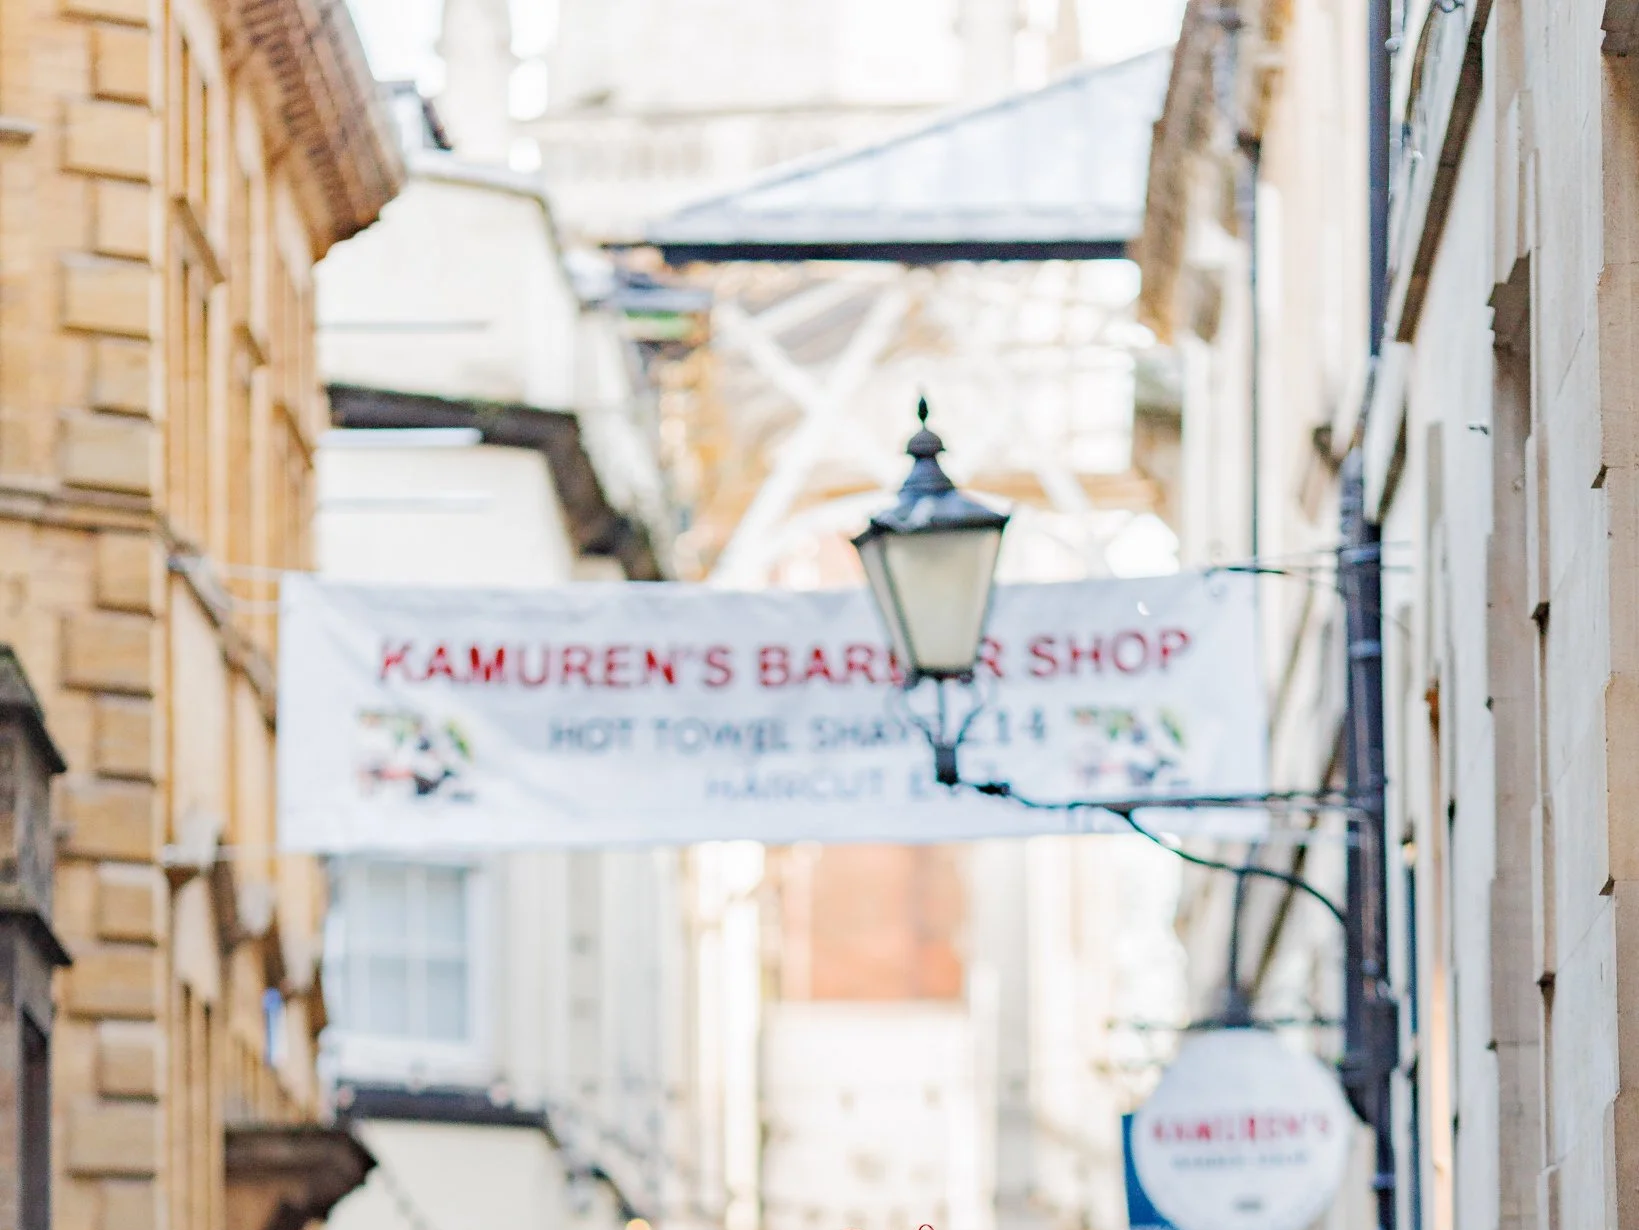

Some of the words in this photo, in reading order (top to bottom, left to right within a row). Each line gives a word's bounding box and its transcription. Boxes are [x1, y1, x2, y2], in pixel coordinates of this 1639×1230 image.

[380, 639, 734, 688] KAMUREN'S
[758, 634, 1004, 688] BARR
[1029, 627, 1191, 678] SHOP
[549, 717, 633, 754] HOT
[653, 715, 789, 753] TOWEL
